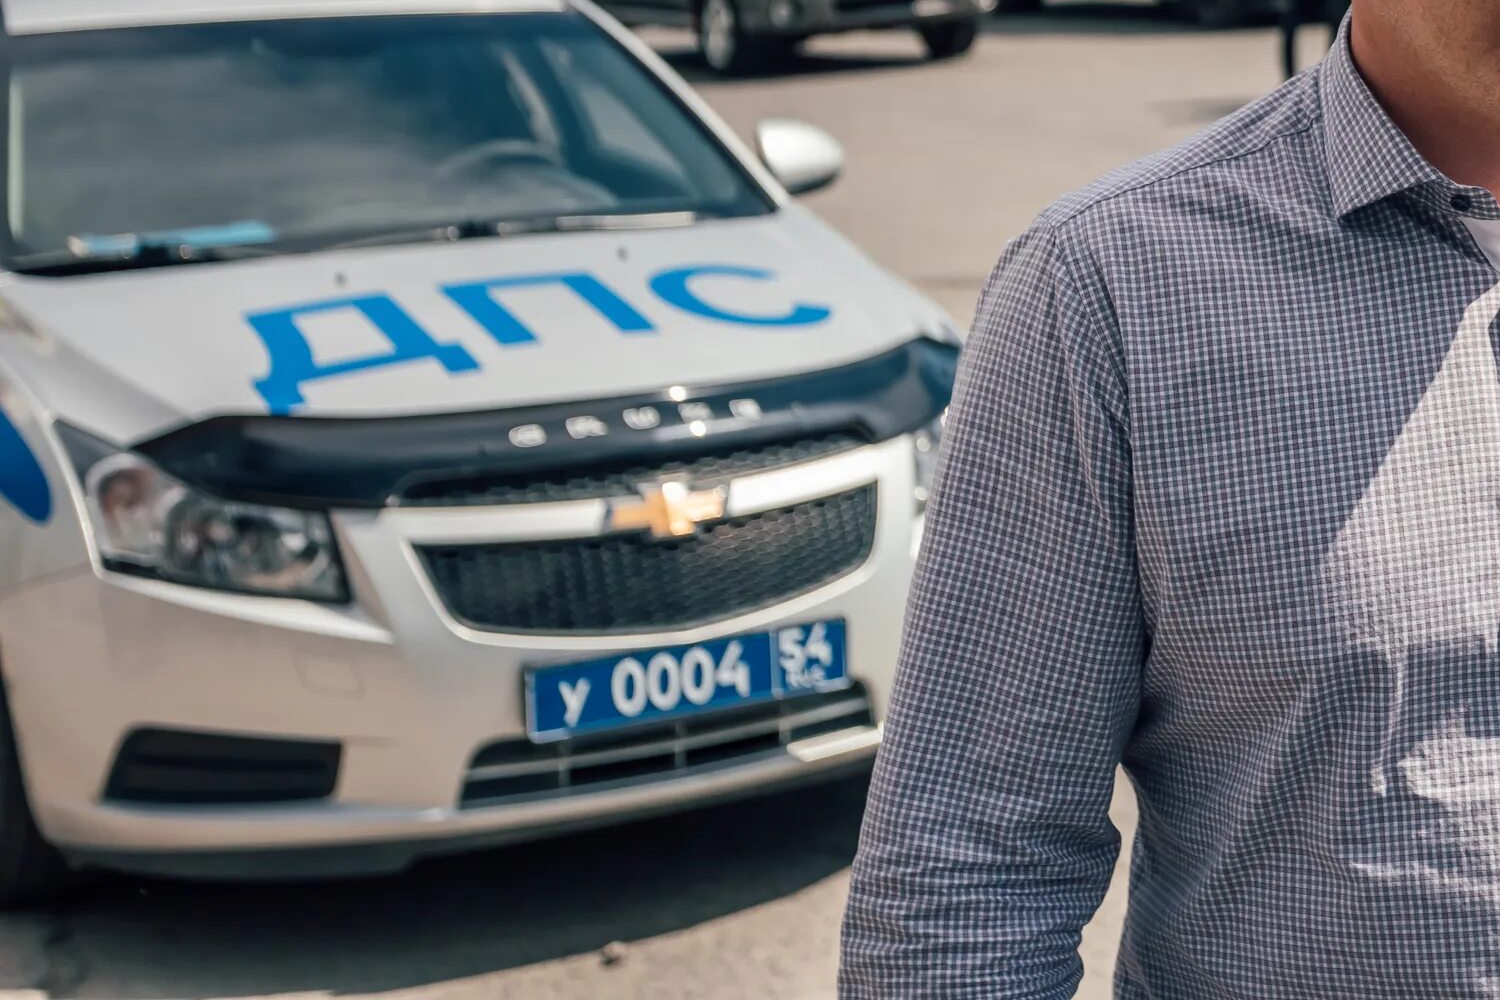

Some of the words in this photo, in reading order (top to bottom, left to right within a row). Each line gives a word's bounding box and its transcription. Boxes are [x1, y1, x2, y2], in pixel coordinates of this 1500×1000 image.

[244, 263, 832, 417] ДПС
[611, 639, 750, 718] 0004
[778, 620, 832, 673] 54
